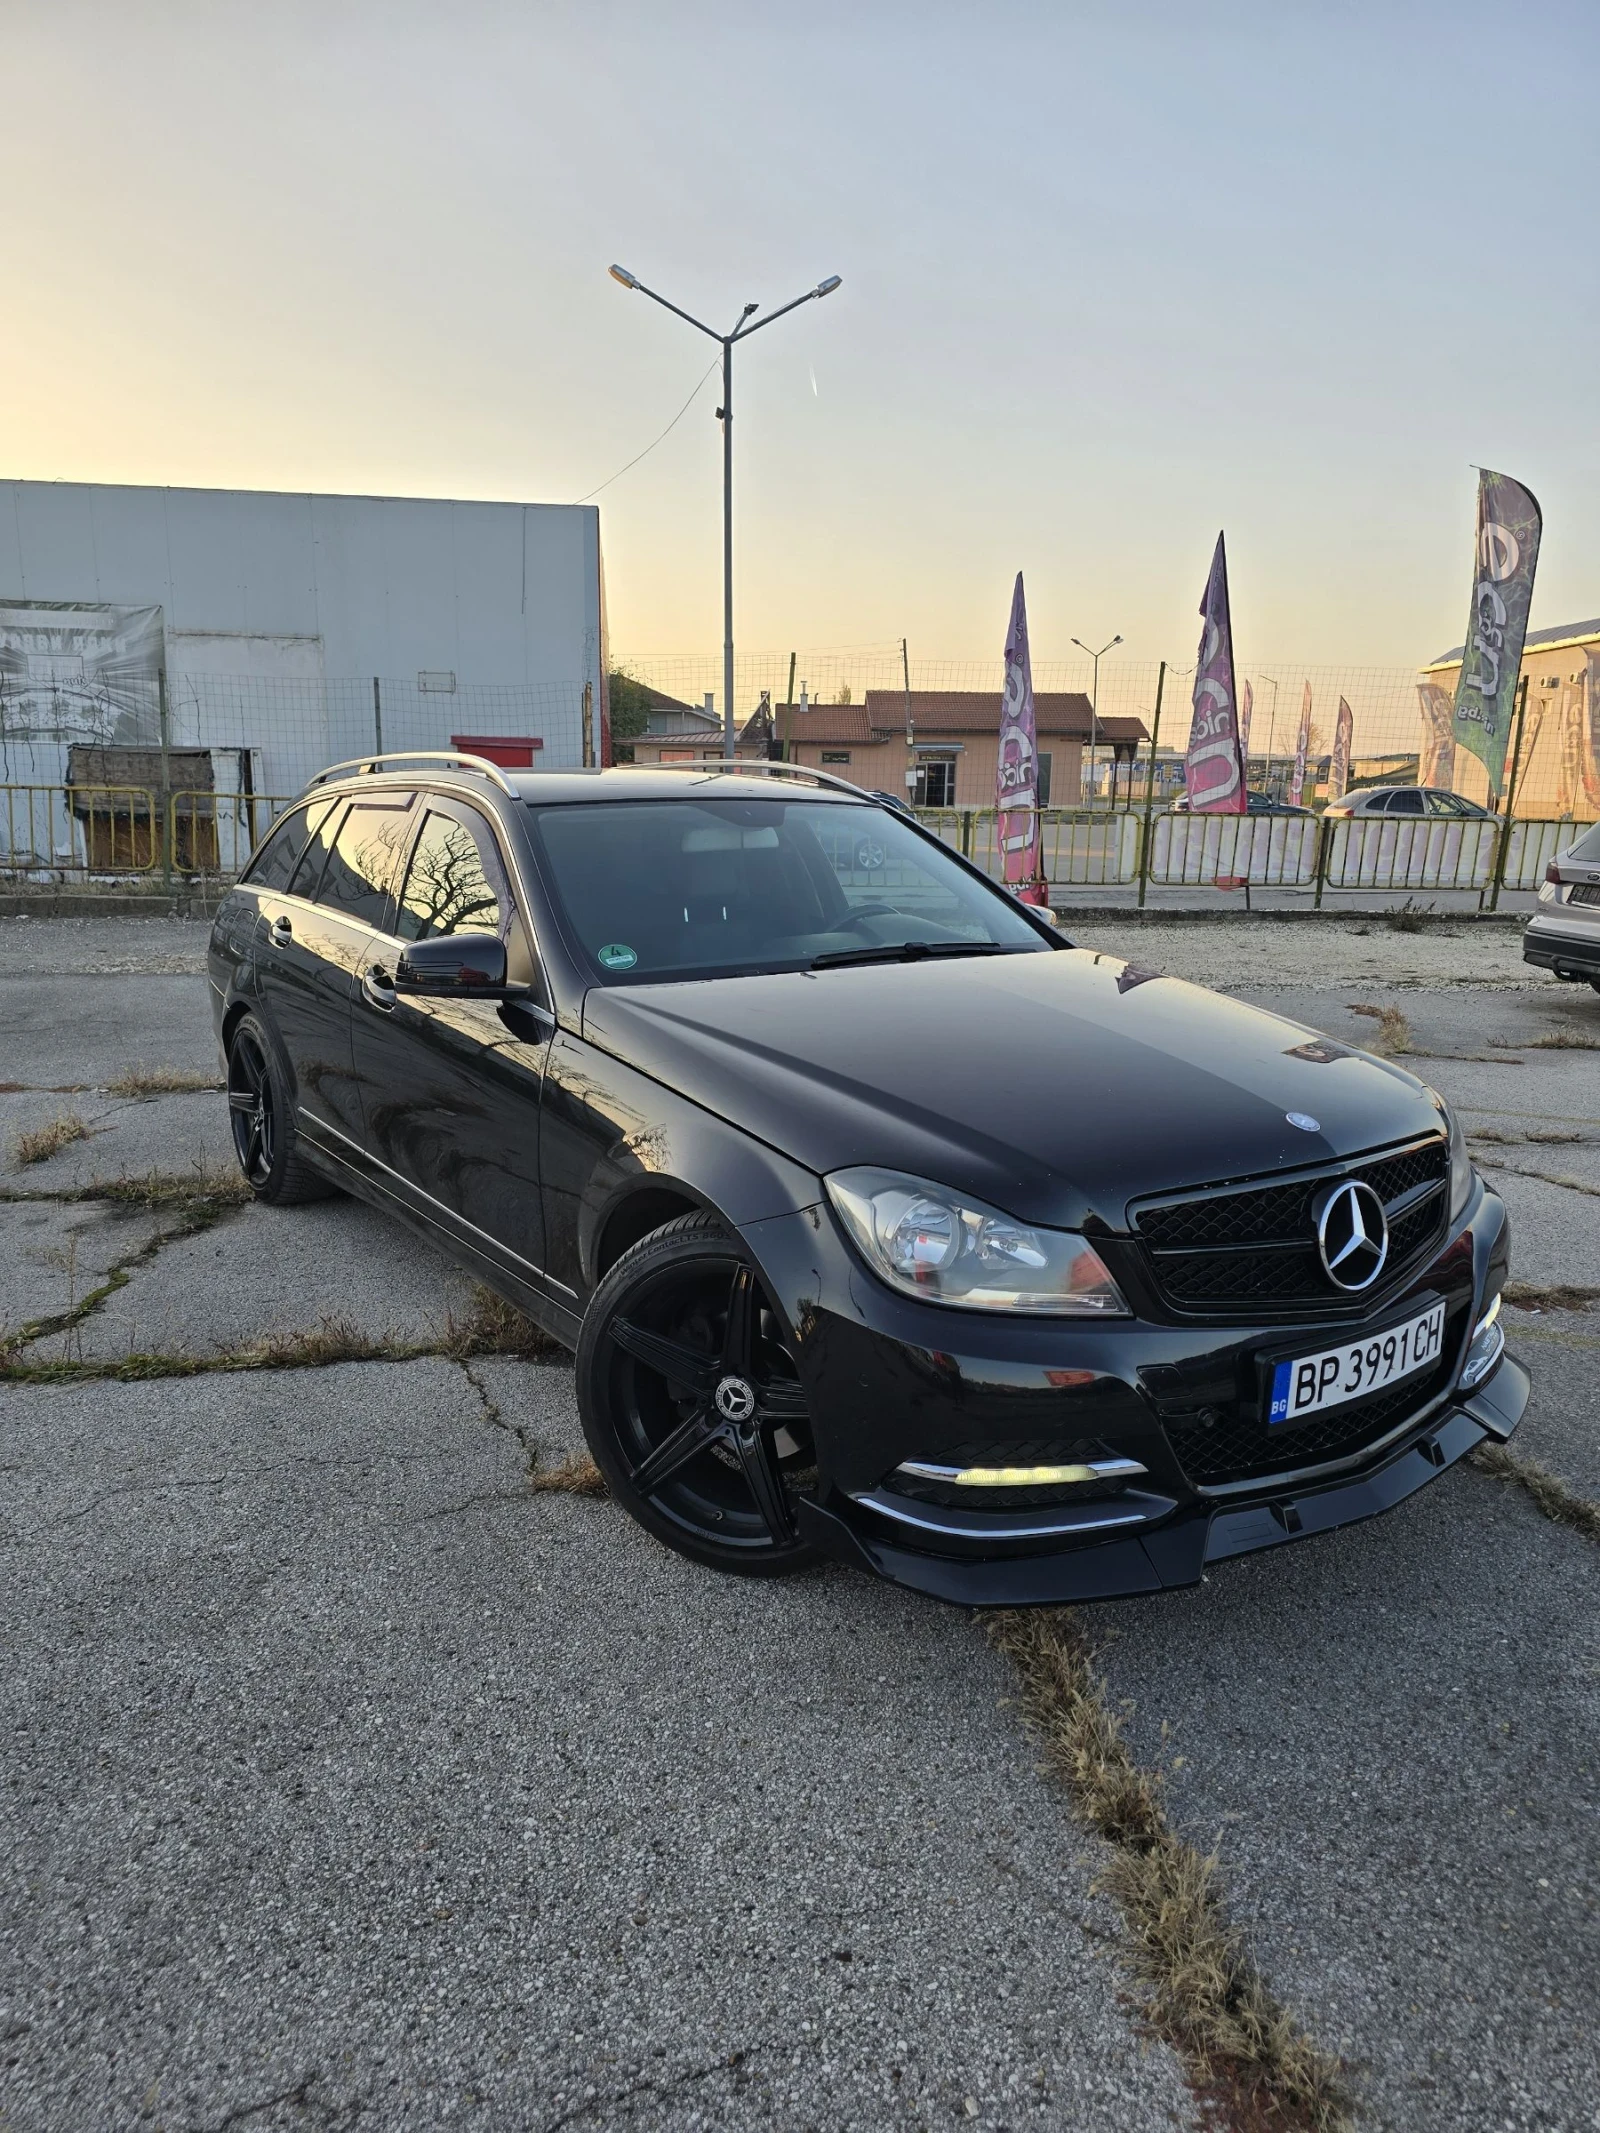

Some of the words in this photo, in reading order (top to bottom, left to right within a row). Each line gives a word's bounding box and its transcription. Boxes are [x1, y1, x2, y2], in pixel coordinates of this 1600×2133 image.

[63, 674, 88, 688] nuts
[1344, 1328, 1409, 1393] 3991
[1271, 1399, 1286, 1415] BG
